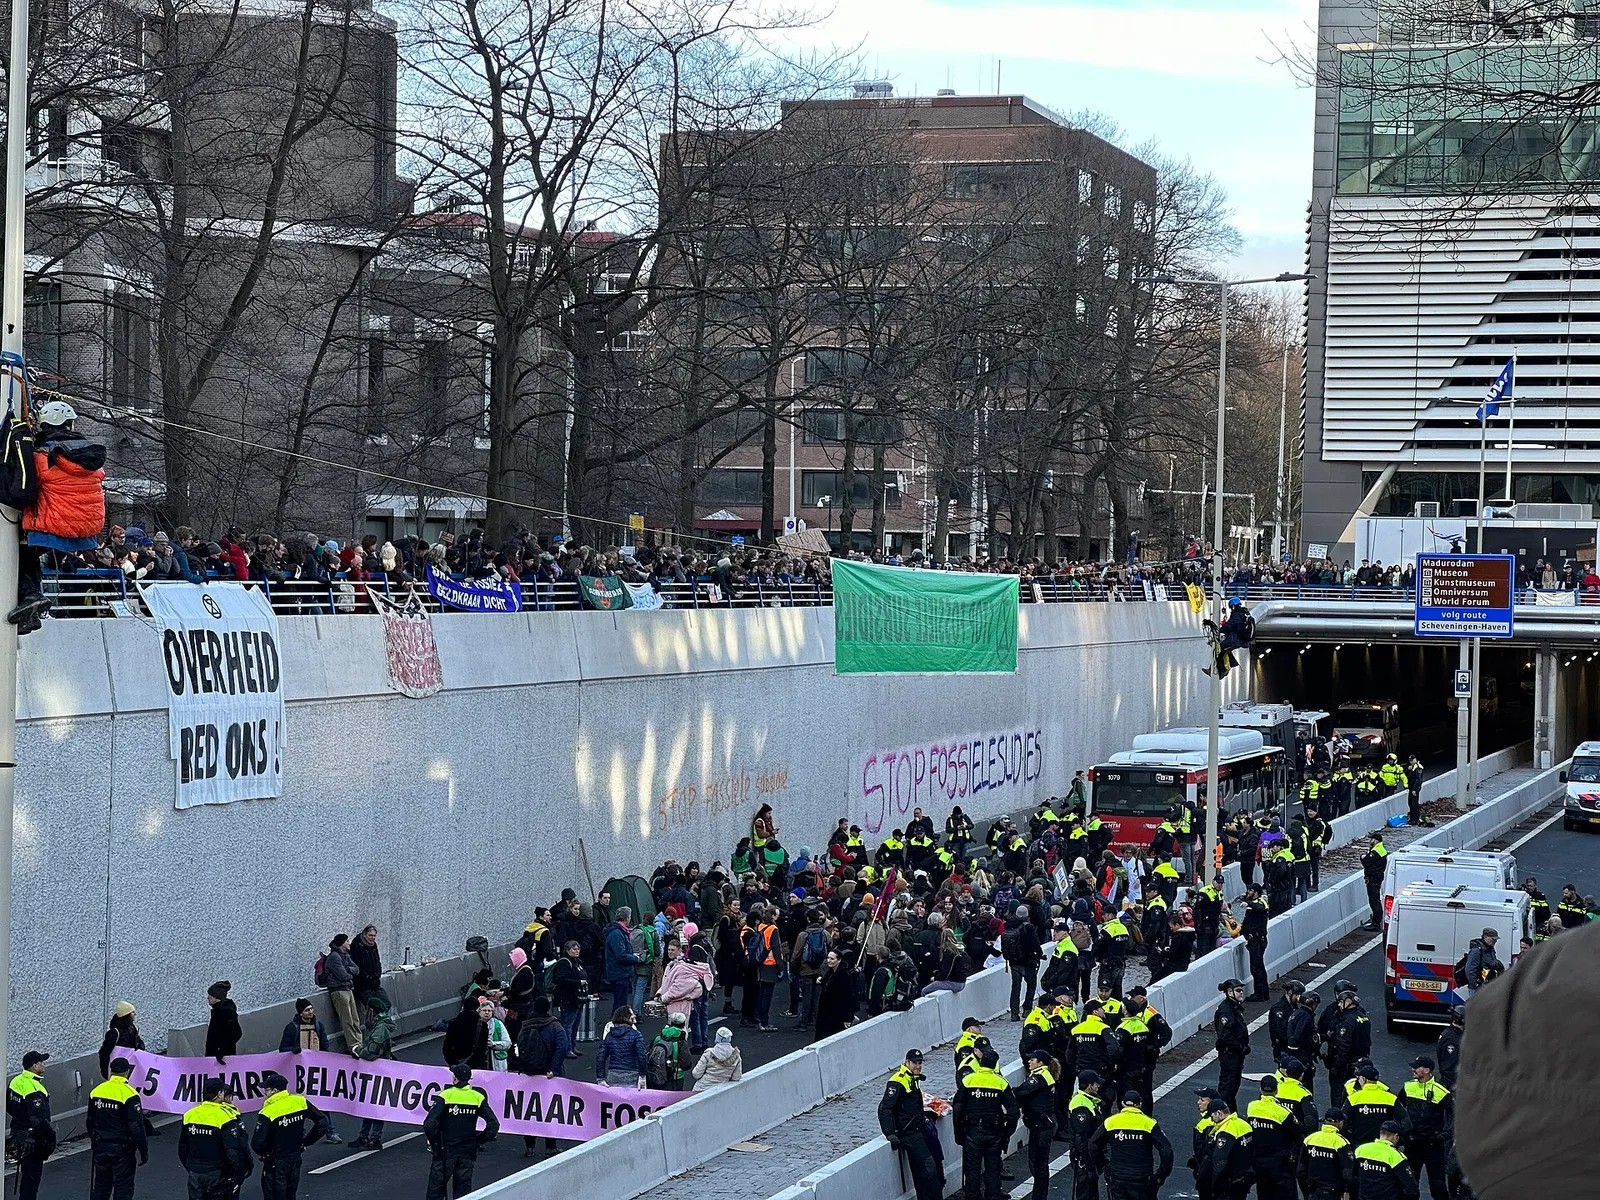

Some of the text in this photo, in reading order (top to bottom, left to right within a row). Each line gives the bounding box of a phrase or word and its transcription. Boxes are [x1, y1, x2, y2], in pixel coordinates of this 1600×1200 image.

[1434, 569, 1468, 577] Museon
[1434, 579, 1496, 587] Kunstmuseum
[1434, 588, 1489, 596] Omniversum
[483, 595, 507, 610] DICHT
[1434, 597, 1490, 606] World Forum
[1441, 611, 1487, 620] volg route
[1421, 621, 1507, 631] Scheveningen-Haven
[163, 628, 280, 695] OVERHEID
[180, 723, 219, 784] RED
[225, 718, 267, 780] ONS
[863, 750, 926, 834] STOP
[659, 784, 696, 831] STOP
[971, 1088, 998, 1098] POLITIE
[94, 1099, 118, 1110] POLITIE
[449, 1104, 476, 1115] POLITIE
[504, 1089, 585, 1126] NAAR
[1358, 1105, 1387, 1114] POLITIE
[278, 1114, 304, 1127] POLITIE
[1250, 1117, 1273, 1129] POLITIE
[188, 1124, 212, 1135] POLITIE
[1114, 1130, 1143, 1141] POLITIE
[1308, 1147, 1334, 1158] POLITIE
[1360, 1159, 1387, 1172] POLITIE
